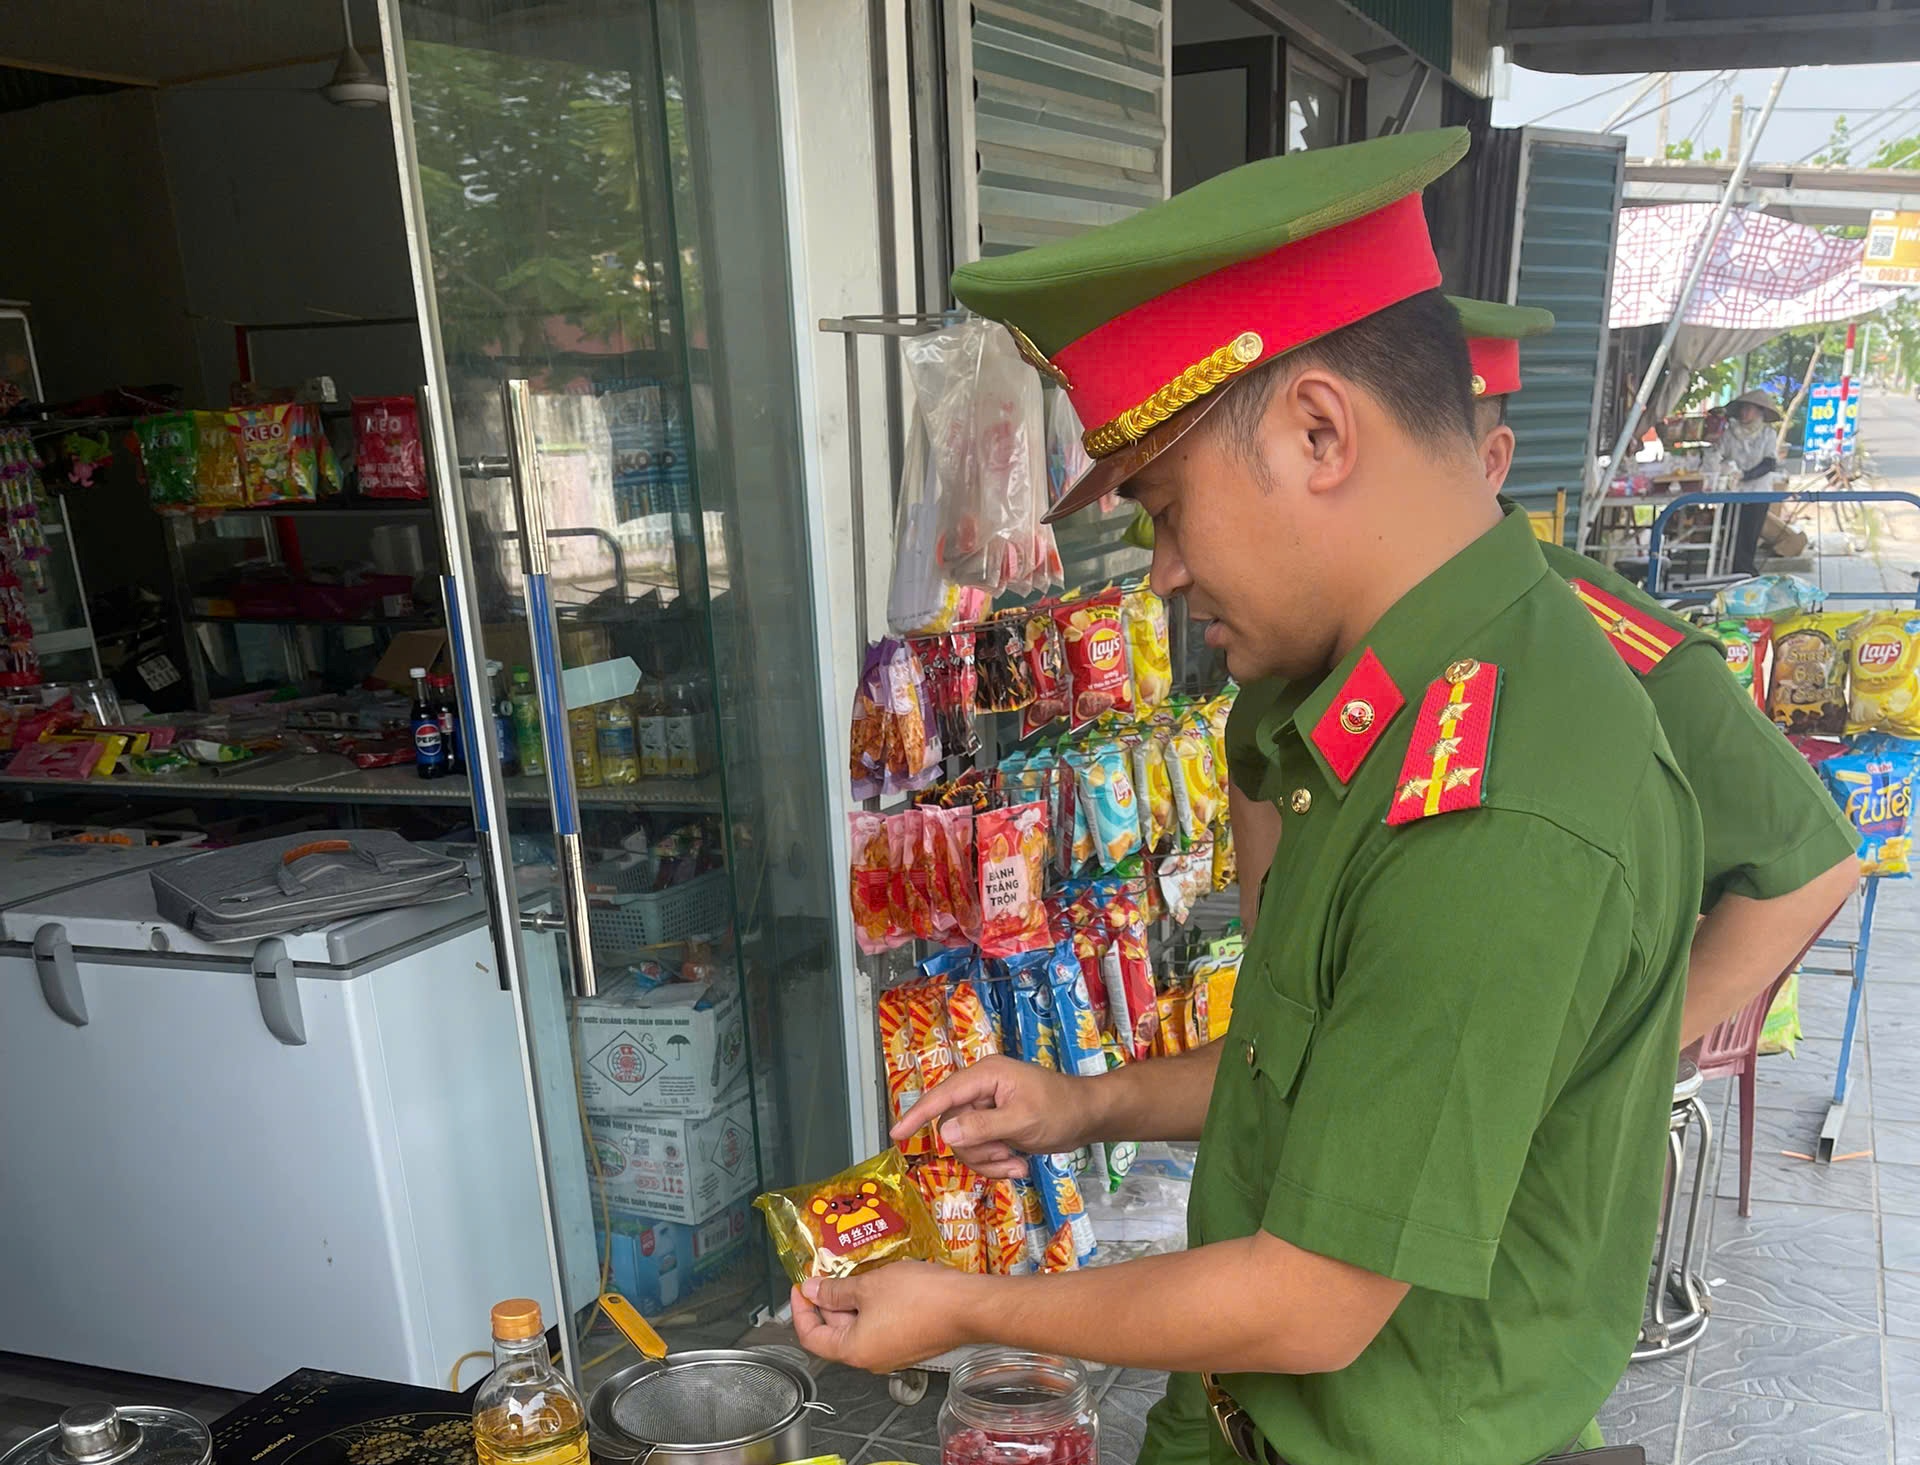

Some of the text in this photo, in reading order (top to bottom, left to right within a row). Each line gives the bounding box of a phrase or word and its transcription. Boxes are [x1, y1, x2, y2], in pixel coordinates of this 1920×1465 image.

[1092, 637, 1120, 662] Lay's
[1726, 645, 1748, 663] ay's
[1861, 642, 1902, 665] Lay's
[935, 1200, 978, 1219] SNACK
[838, 1218, 889, 1247] 肉丝汉堡
